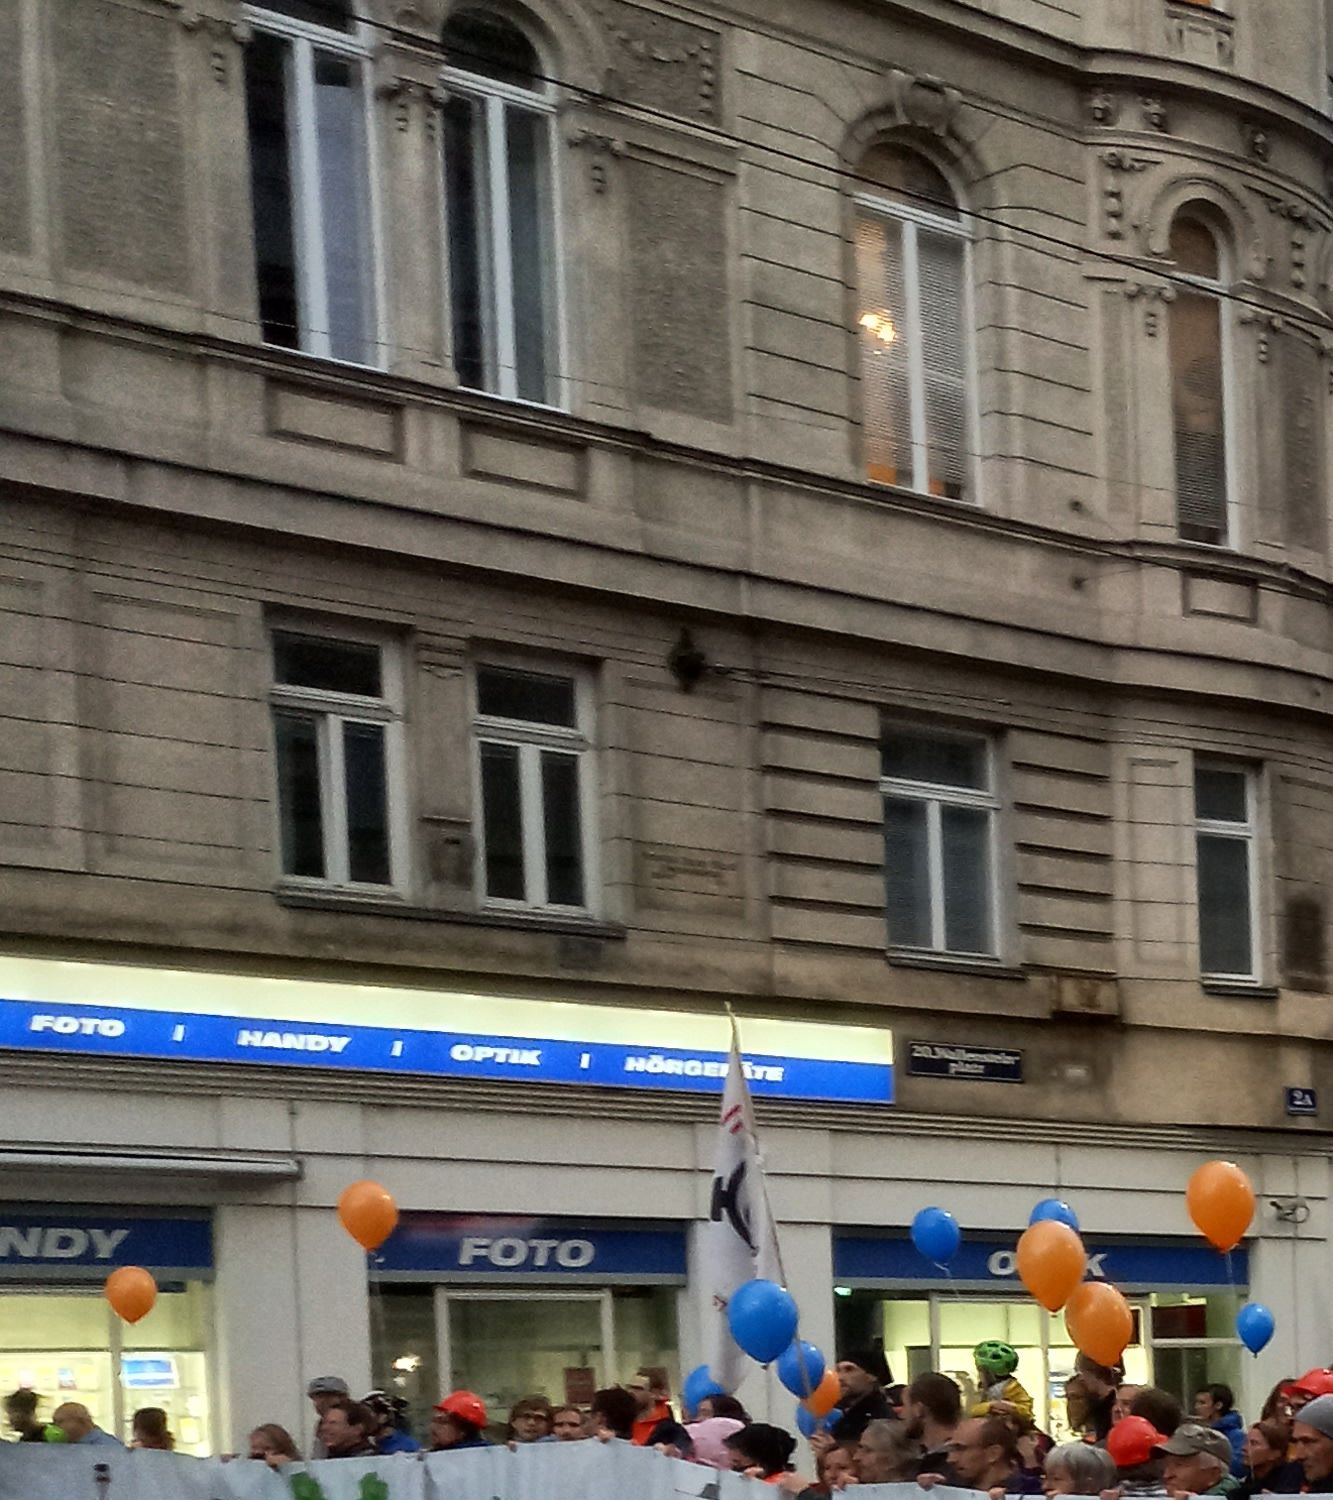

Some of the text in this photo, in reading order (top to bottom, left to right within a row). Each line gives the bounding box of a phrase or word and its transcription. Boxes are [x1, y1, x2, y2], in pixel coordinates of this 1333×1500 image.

[30, 1013, 126, 1038] FOTO
[236, 1029, 352, 1054] HANDY
[449, 1043, 543, 1067] OPTIK
[458, 1236, 596, 1268] FOTO
